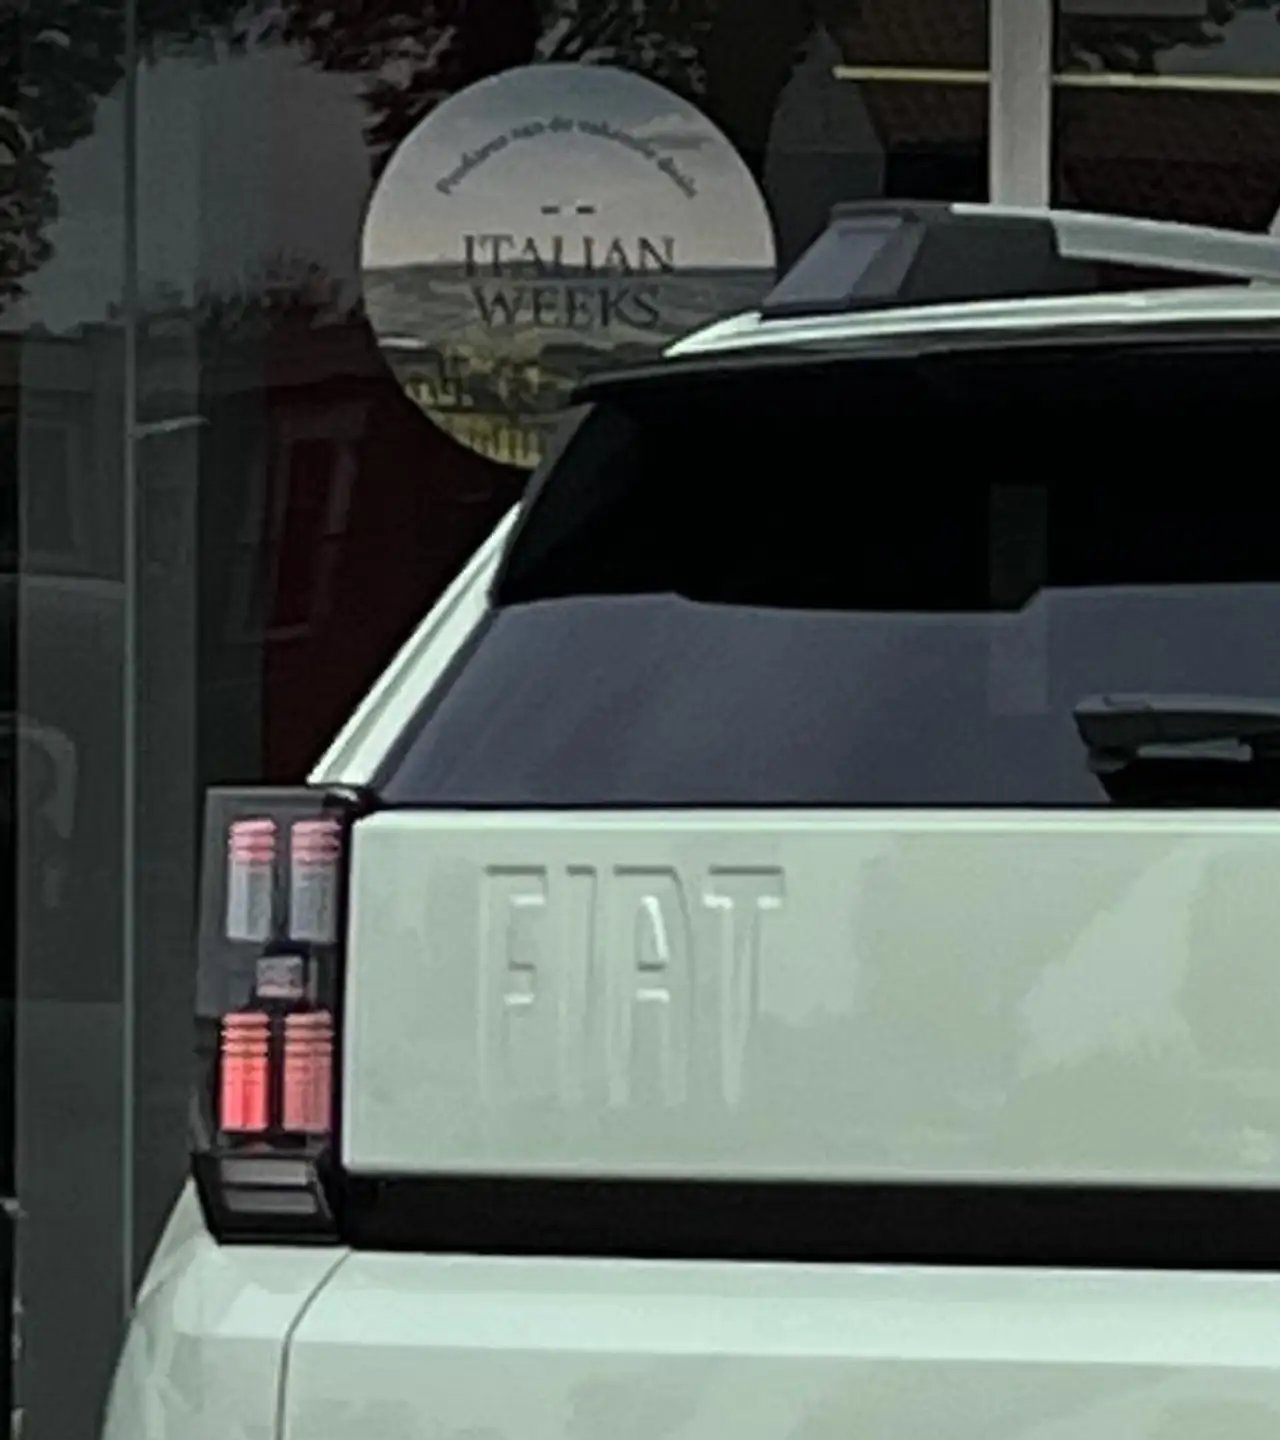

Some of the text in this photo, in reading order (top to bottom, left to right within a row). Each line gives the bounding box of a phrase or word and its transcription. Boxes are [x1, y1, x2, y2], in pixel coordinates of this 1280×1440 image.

[462, 234, 676, 278] ITALIAN
[469, 283, 660, 329] WEEKS
[477, 864, 785, 1110] FIAT
